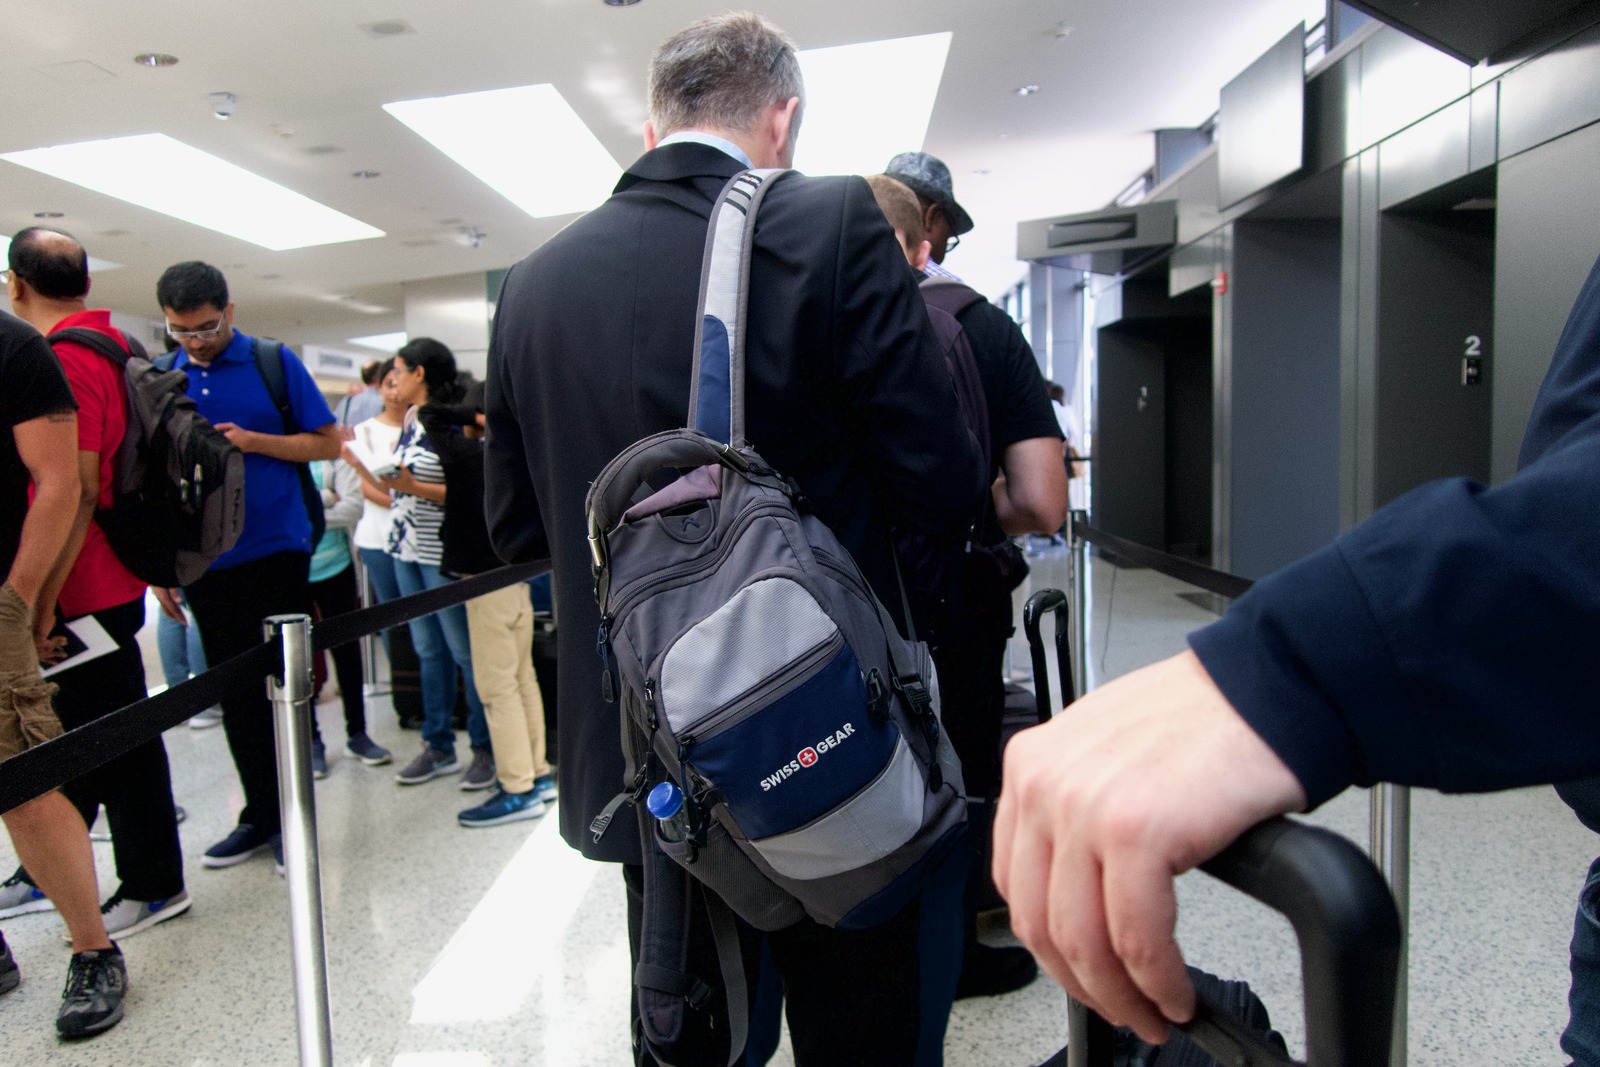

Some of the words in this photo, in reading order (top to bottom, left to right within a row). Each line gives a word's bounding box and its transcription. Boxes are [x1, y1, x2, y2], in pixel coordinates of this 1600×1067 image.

[1464, 335, 1481, 356] 2
[760, 760, 800, 791] SWISS
[816, 722, 856, 754] GEAR
